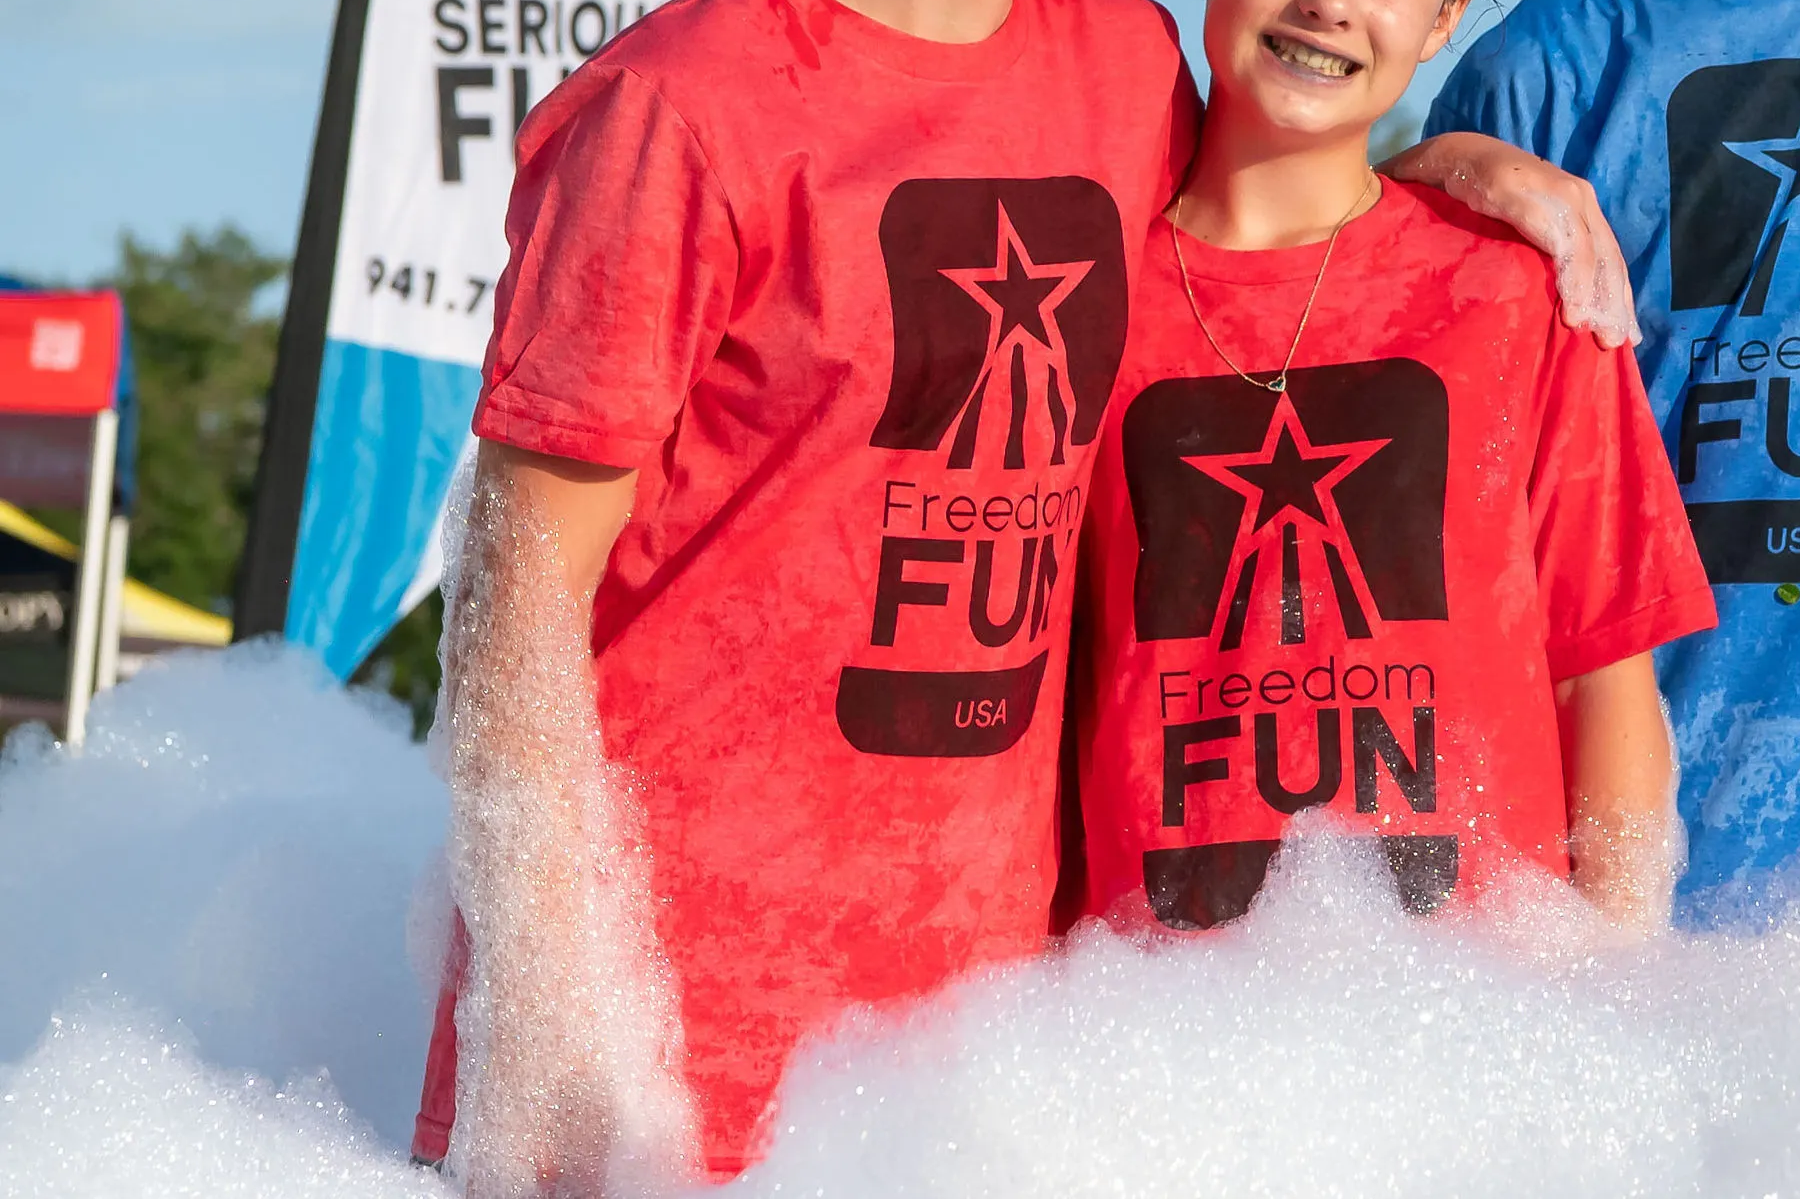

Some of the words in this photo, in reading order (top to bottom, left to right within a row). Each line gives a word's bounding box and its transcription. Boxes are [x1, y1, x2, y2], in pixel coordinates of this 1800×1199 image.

[883, 480, 1081, 532] Freedom
[870, 529, 1073, 648] FUN
[954, 698, 1007, 729] USA
[1159, 656, 1435, 719] Freedom
[1162, 707, 1437, 827] FUN
